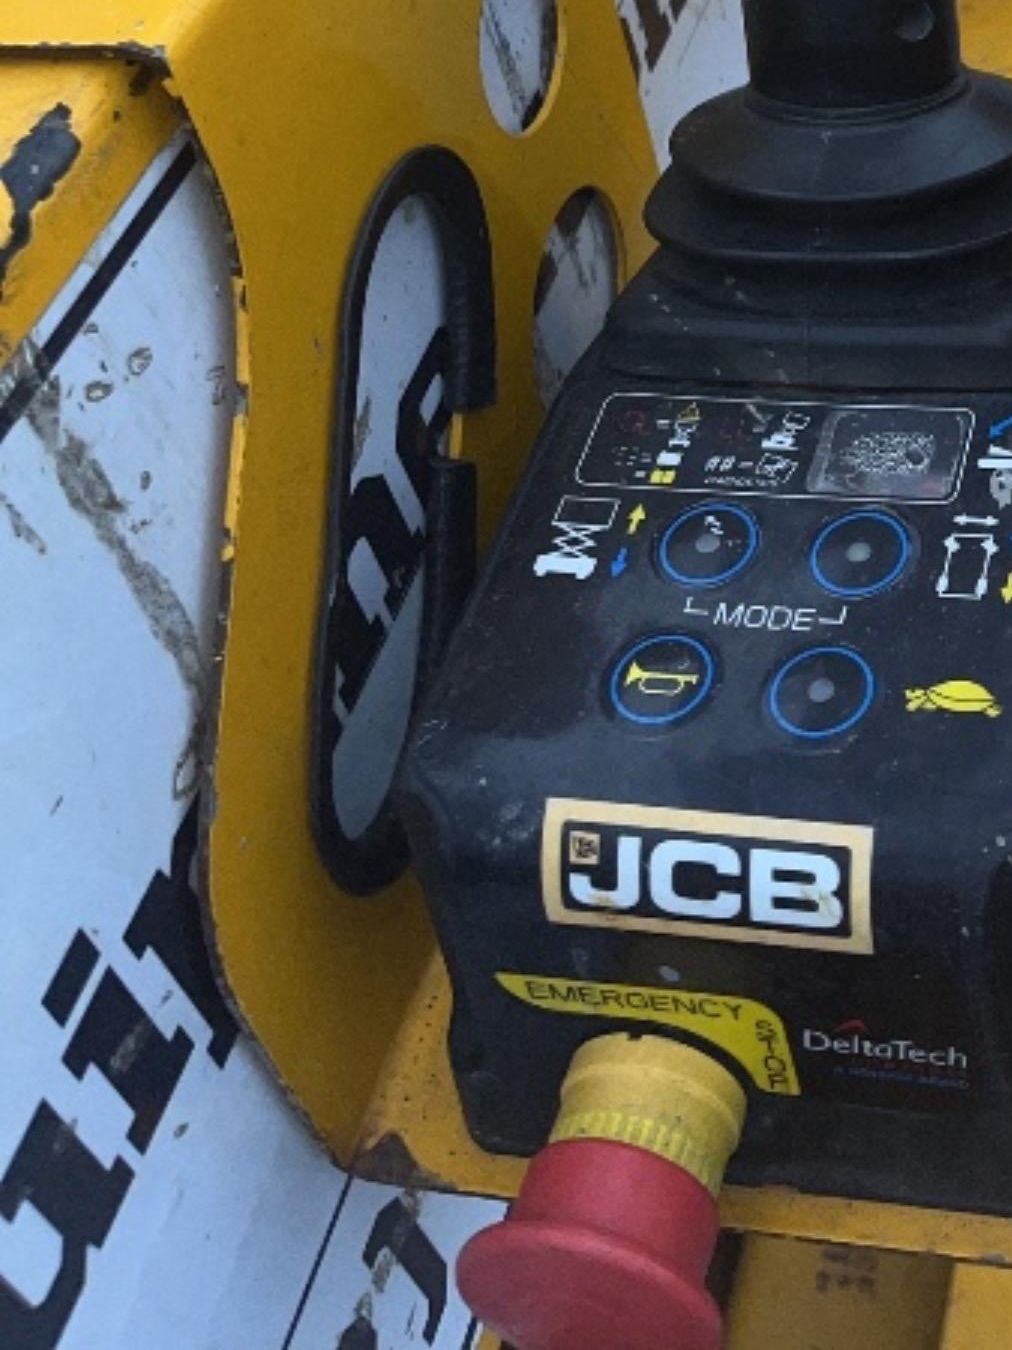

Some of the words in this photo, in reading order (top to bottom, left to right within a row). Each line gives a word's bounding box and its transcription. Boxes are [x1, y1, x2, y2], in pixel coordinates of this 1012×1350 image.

[712, 601, 818, 632] MODE
[569, 836, 844, 928] JCB
[525, 980, 742, 1021] EMERGENCY
[756, 1019, 789, 1090] STOP
[802, 1028, 968, 1070] DeltaTech
